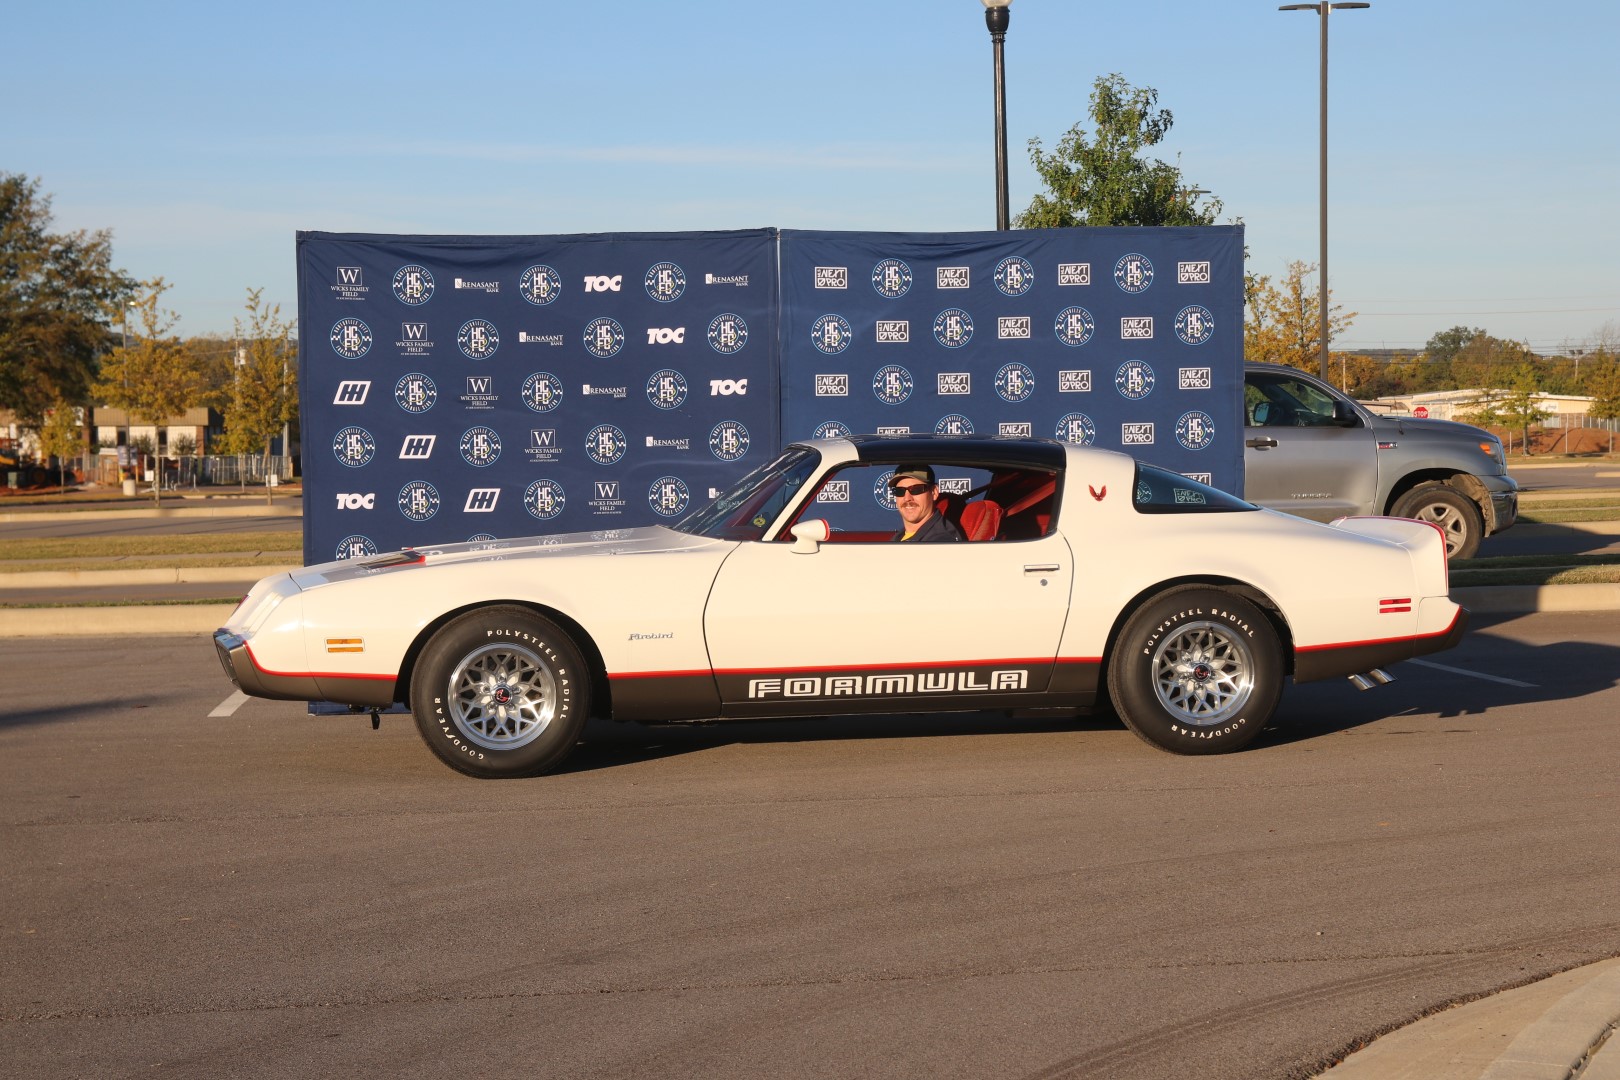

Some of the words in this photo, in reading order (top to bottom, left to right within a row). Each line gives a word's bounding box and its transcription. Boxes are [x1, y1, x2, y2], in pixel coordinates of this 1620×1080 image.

[885, 266, 898, 278] HC
[1007, 264, 1020, 276] HC
[1127, 262, 1140, 273] HC
[339, 269, 359, 283] W
[407, 273, 420, 285] HC
[534, 273, 547, 285] HC
[659, 270, 672, 282] HC
[1128, 274, 1141, 286] FC
[584, 276, 622, 292] TOC
[659, 282, 672, 294] FC
[886, 279, 899, 290] FC
[1008, 277, 1021, 288] FC
[407, 285, 420, 297] FC
[534, 285, 547, 297] FC
[947, 316, 960, 328] HC
[1068, 315, 1081, 327] HC
[1188, 313, 1201, 325] HC
[345, 326, 358, 338] HC
[404, 324, 424, 339] W
[472, 328, 485, 339] HC
[597, 326, 610, 338] HC
[721, 322, 734, 334] HC
[825, 322, 838, 334] HC
[1068, 327, 1081, 339] FC
[1188, 325, 1201, 337] FC
[647, 328, 685, 344] TOC
[722, 334, 734, 346] FC
[825, 335, 838, 346] FC
[947, 329, 960, 340] FC
[345, 339, 358, 350] FC
[472, 340, 485, 352] FC
[598, 338, 611, 350] FC
[886, 373, 900, 385] HC
[1008, 371, 1021, 383] HC
[1128, 368, 1142, 380] HC
[409, 381, 422, 393] HC
[469, 378, 489, 393] W
[536, 380, 549, 392] HC
[660, 378, 674, 389] HC
[710, 379, 748, 396] TOC
[1008, 383, 1021, 395] FC
[1129, 380, 1142, 392] FC
[661, 390, 674, 402] FC
[887, 385, 900, 397] FC
[410, 393, 422, 405] FC
[536, 393, 549, 404] FC
[1069, 420, 1082, 432] HC
[1188, 419, 1202, 431] HC
[347, 435, 360, 447] HC
[474, 435, 487, 447] HC
[533, 431, 553, 446] W
[599, 433, 612, 445] HC
[723, 429, 736, 441] HC
[1189, 431, 1202, 443] FC
[348, 447, 361, 459] FC
[474, 447, 487, 459] FC
[600, 445, 612, 457] FC
[723, 441, 736, 453] FC
[597, 483, 616, 498] W
[662, 484, 675, 496] HC
[945, 480, 968, 489] NEXT
[412, 489, 425, 501] HC
[538, 488, 551, 499] HC
[828, 492, 846, 500] PRO
[337, 493, 375, 510] TOC
[413, 501, 426, 513] FC
[538, 500, 551, 512] FC
[662, 497, 675, 508] FC
[350, 544, 363, 555] HC
[628, 632, 674, 641] Firebird
[1144, 608, 1202, 655] POLYSTEEL
[1212, 609, 1255, 638] RADIAL
[487, 629, 556, 662] POLYSTEEL
[558, 668, 571, 720] RADIAL
[748, 669, 1028, 698] FORMULA
[435, 697, 484, 760] GOODYEAR
[1171, 718, 1246, 739] GOODYEAR
